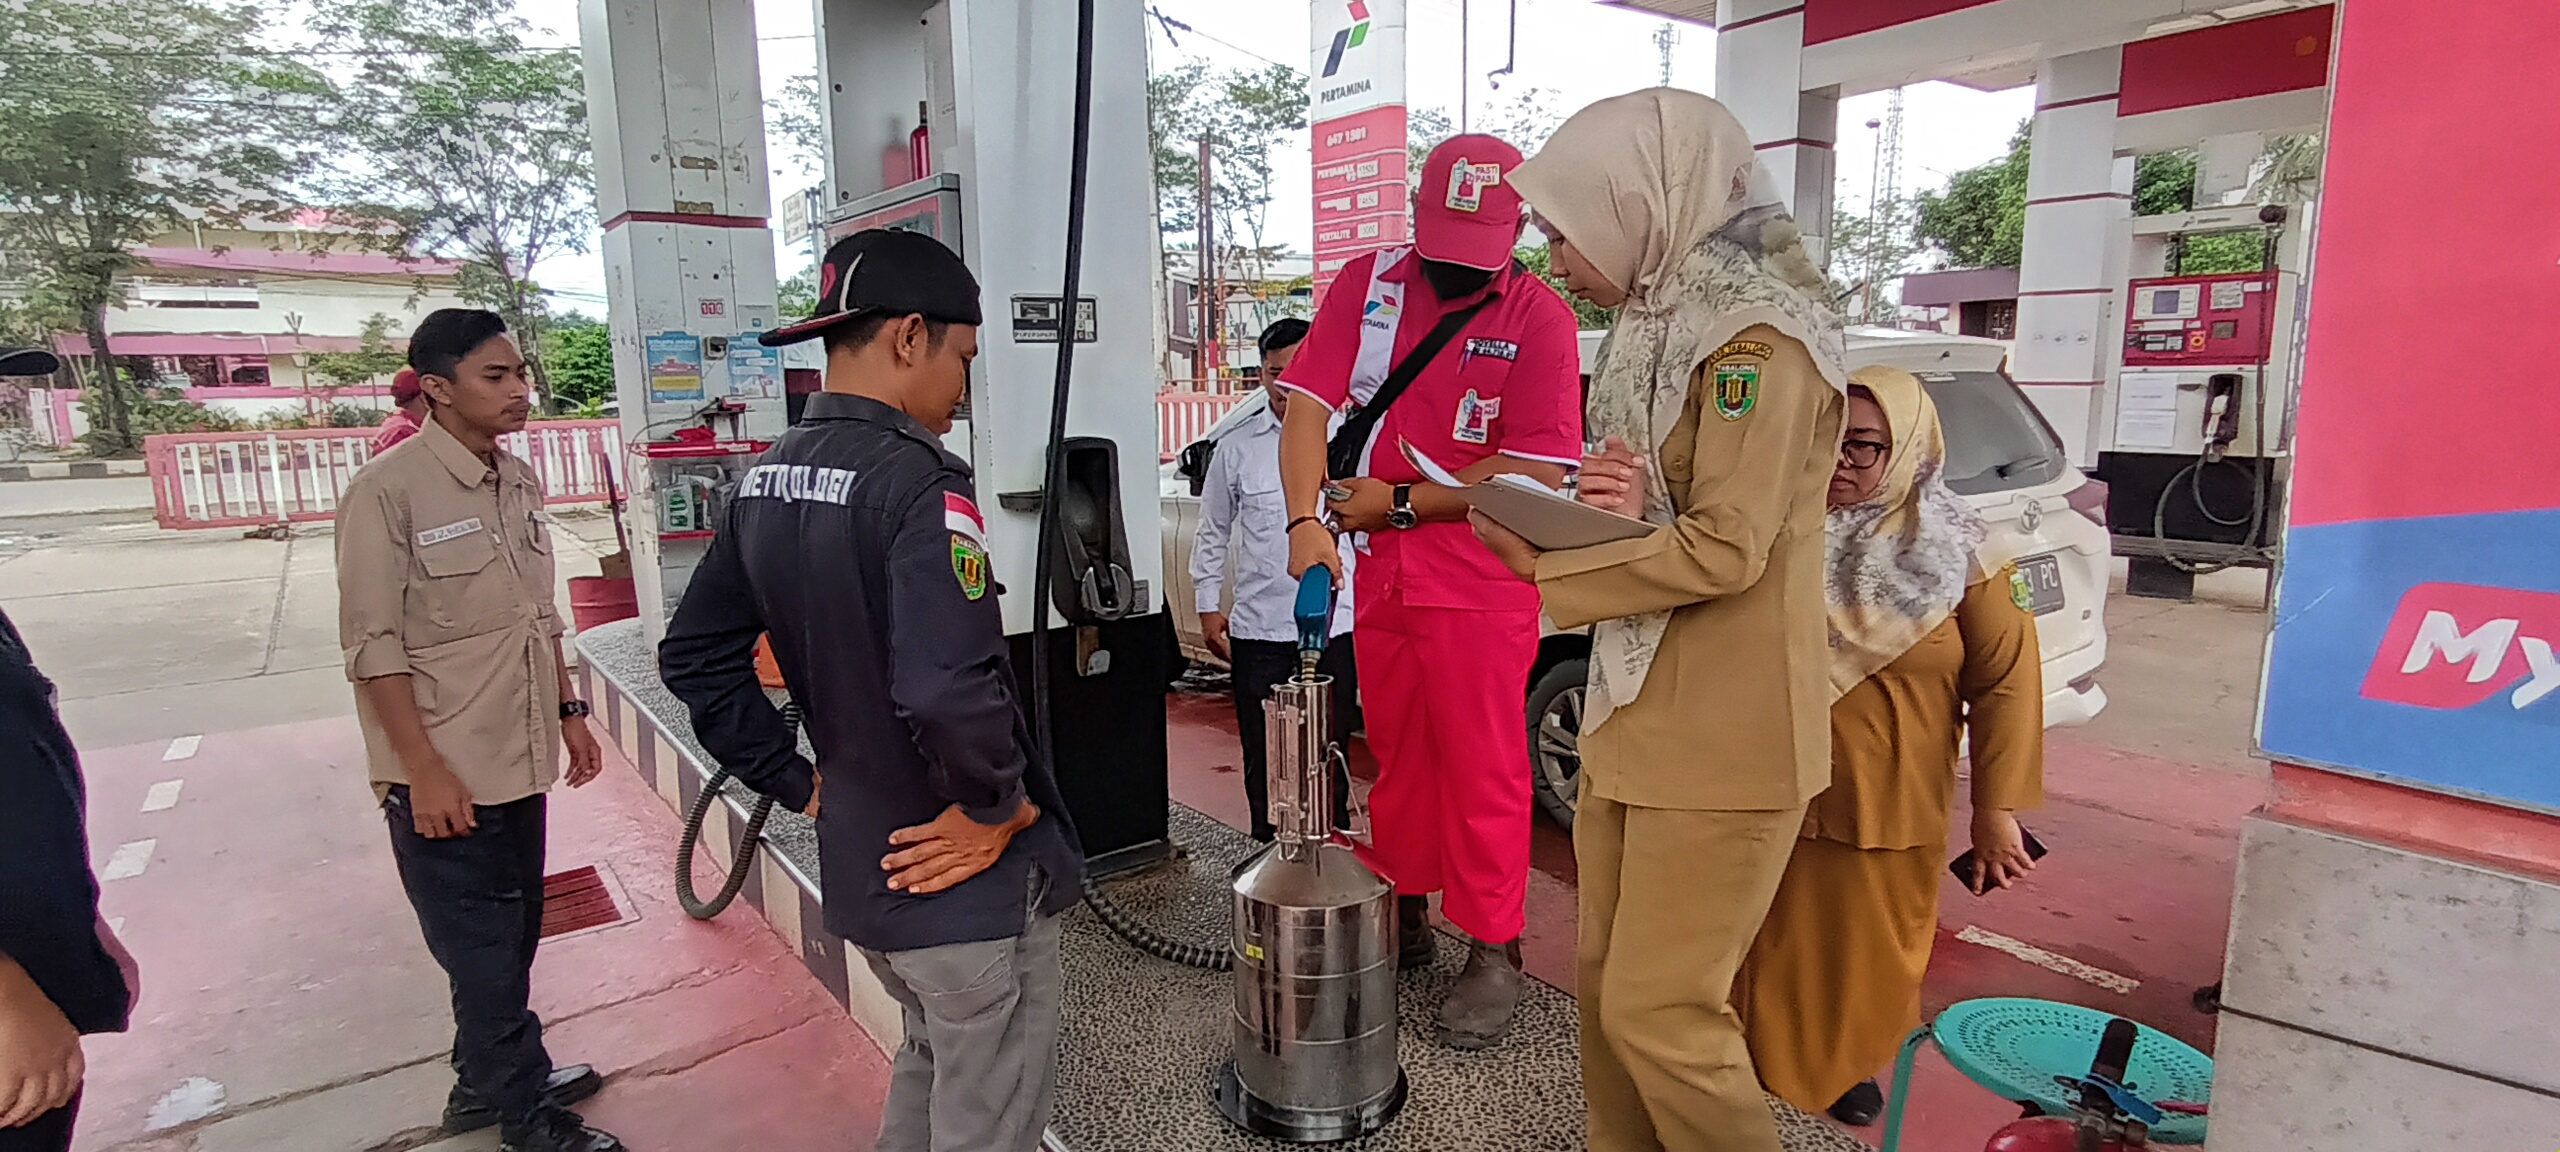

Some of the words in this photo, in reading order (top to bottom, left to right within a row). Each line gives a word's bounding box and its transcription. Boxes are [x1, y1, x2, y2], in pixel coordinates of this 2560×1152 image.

[1321, 79, 1372, 104] PERTAMINA
[1716, 364, 1756, 373] TABALONG
[739, 464, 857, 505] METROLOGI
[2040, 562, 2058, 590] PC
